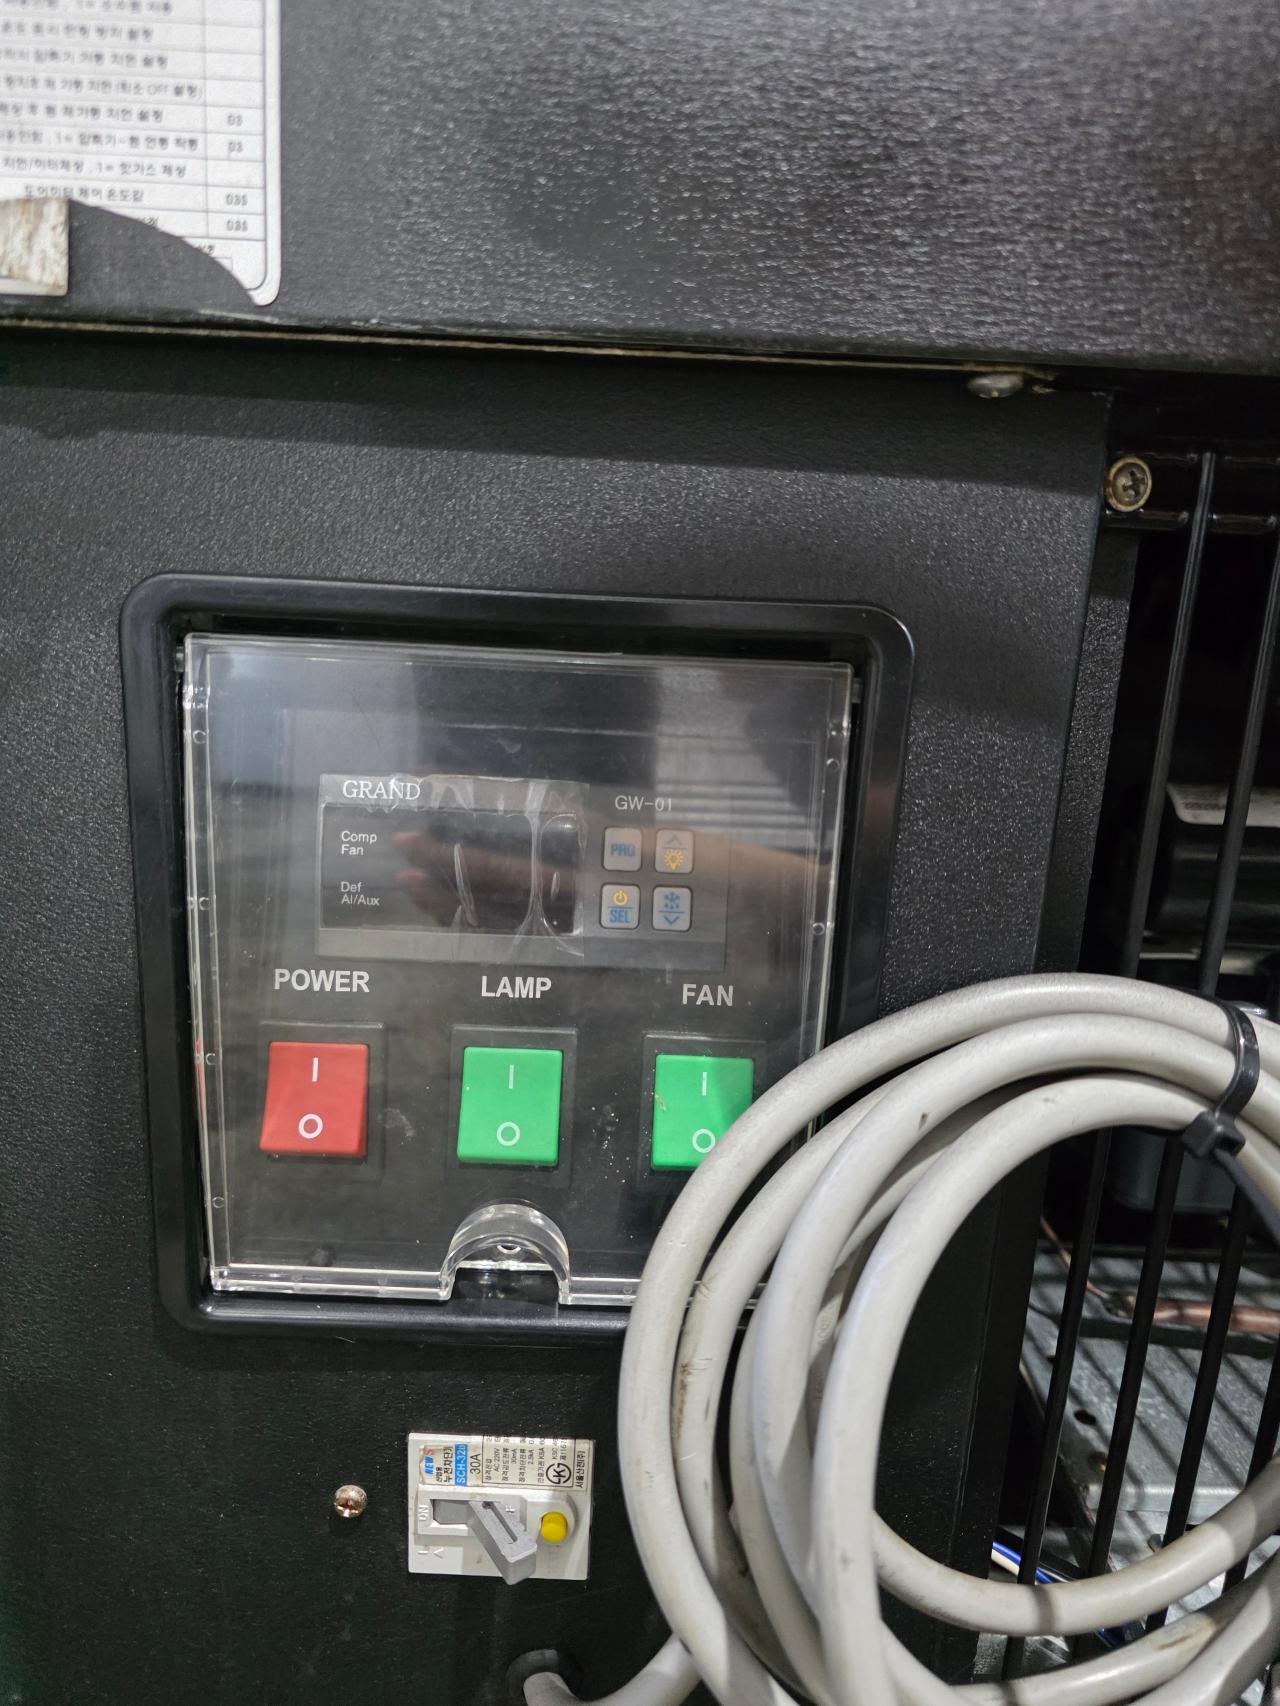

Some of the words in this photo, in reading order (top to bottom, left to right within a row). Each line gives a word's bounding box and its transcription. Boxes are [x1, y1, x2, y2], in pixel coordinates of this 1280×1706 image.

[342, 779, 421, 800] GRAND
[614, 795, 673, 813] GW-01
[340, 830, 378, 845] Comp
[340, 844, 364, 856] Fan
[610, 843, 636, 857] PRG
[340, 881, 362, 893] Def
[609, 908, 630, 924] SEL
[273, 968, 371, 994] POWER
[480, 975, 552, 999] LAMP
[681, 984, 735, 1007] FAN
[469, 1453, 481, 1475] 30A
